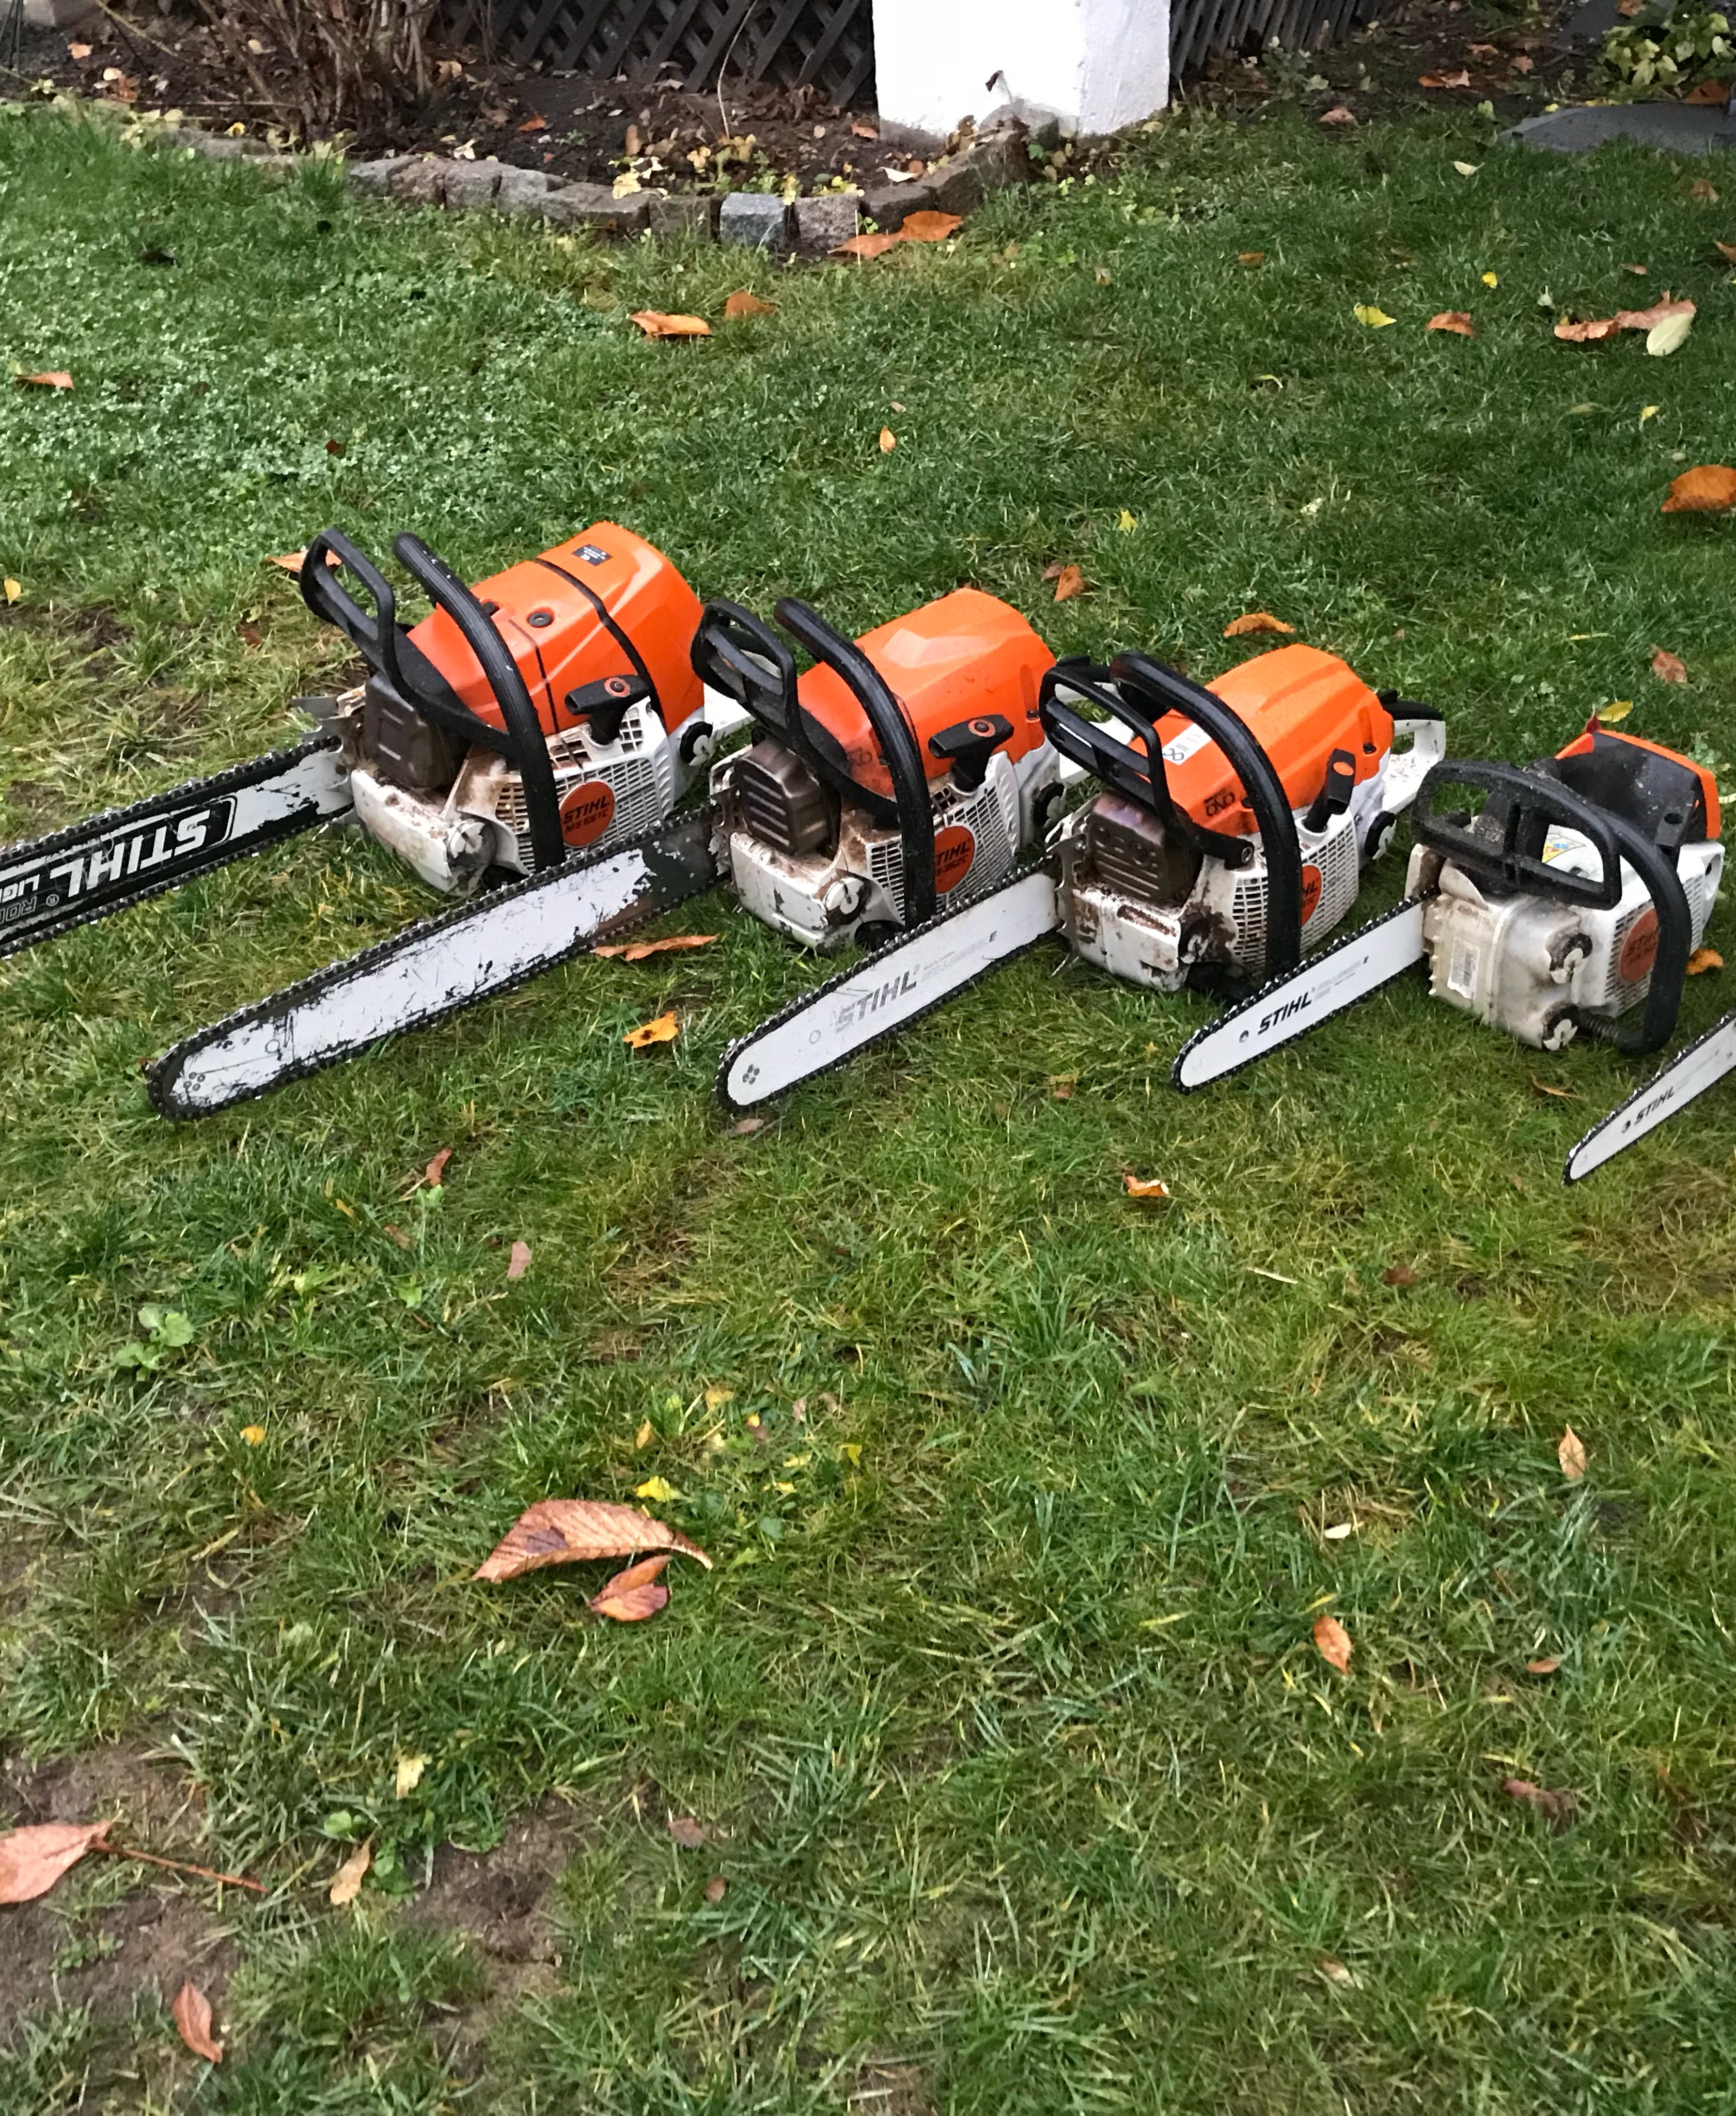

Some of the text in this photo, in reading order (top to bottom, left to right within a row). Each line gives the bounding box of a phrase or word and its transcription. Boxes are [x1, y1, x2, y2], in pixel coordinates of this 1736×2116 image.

[563, 796, 610, 825] STIHL
[50, 810, 210, 898] STIHL
[935, 841, 971, 866] TIHL
[0, 874, 40, 904] LIG
[836, 971, 917, 1032] STIHL
[1257, 991, 1312, 1036] STIHL
[1634, 1086, 1675, 1125] STIHL
